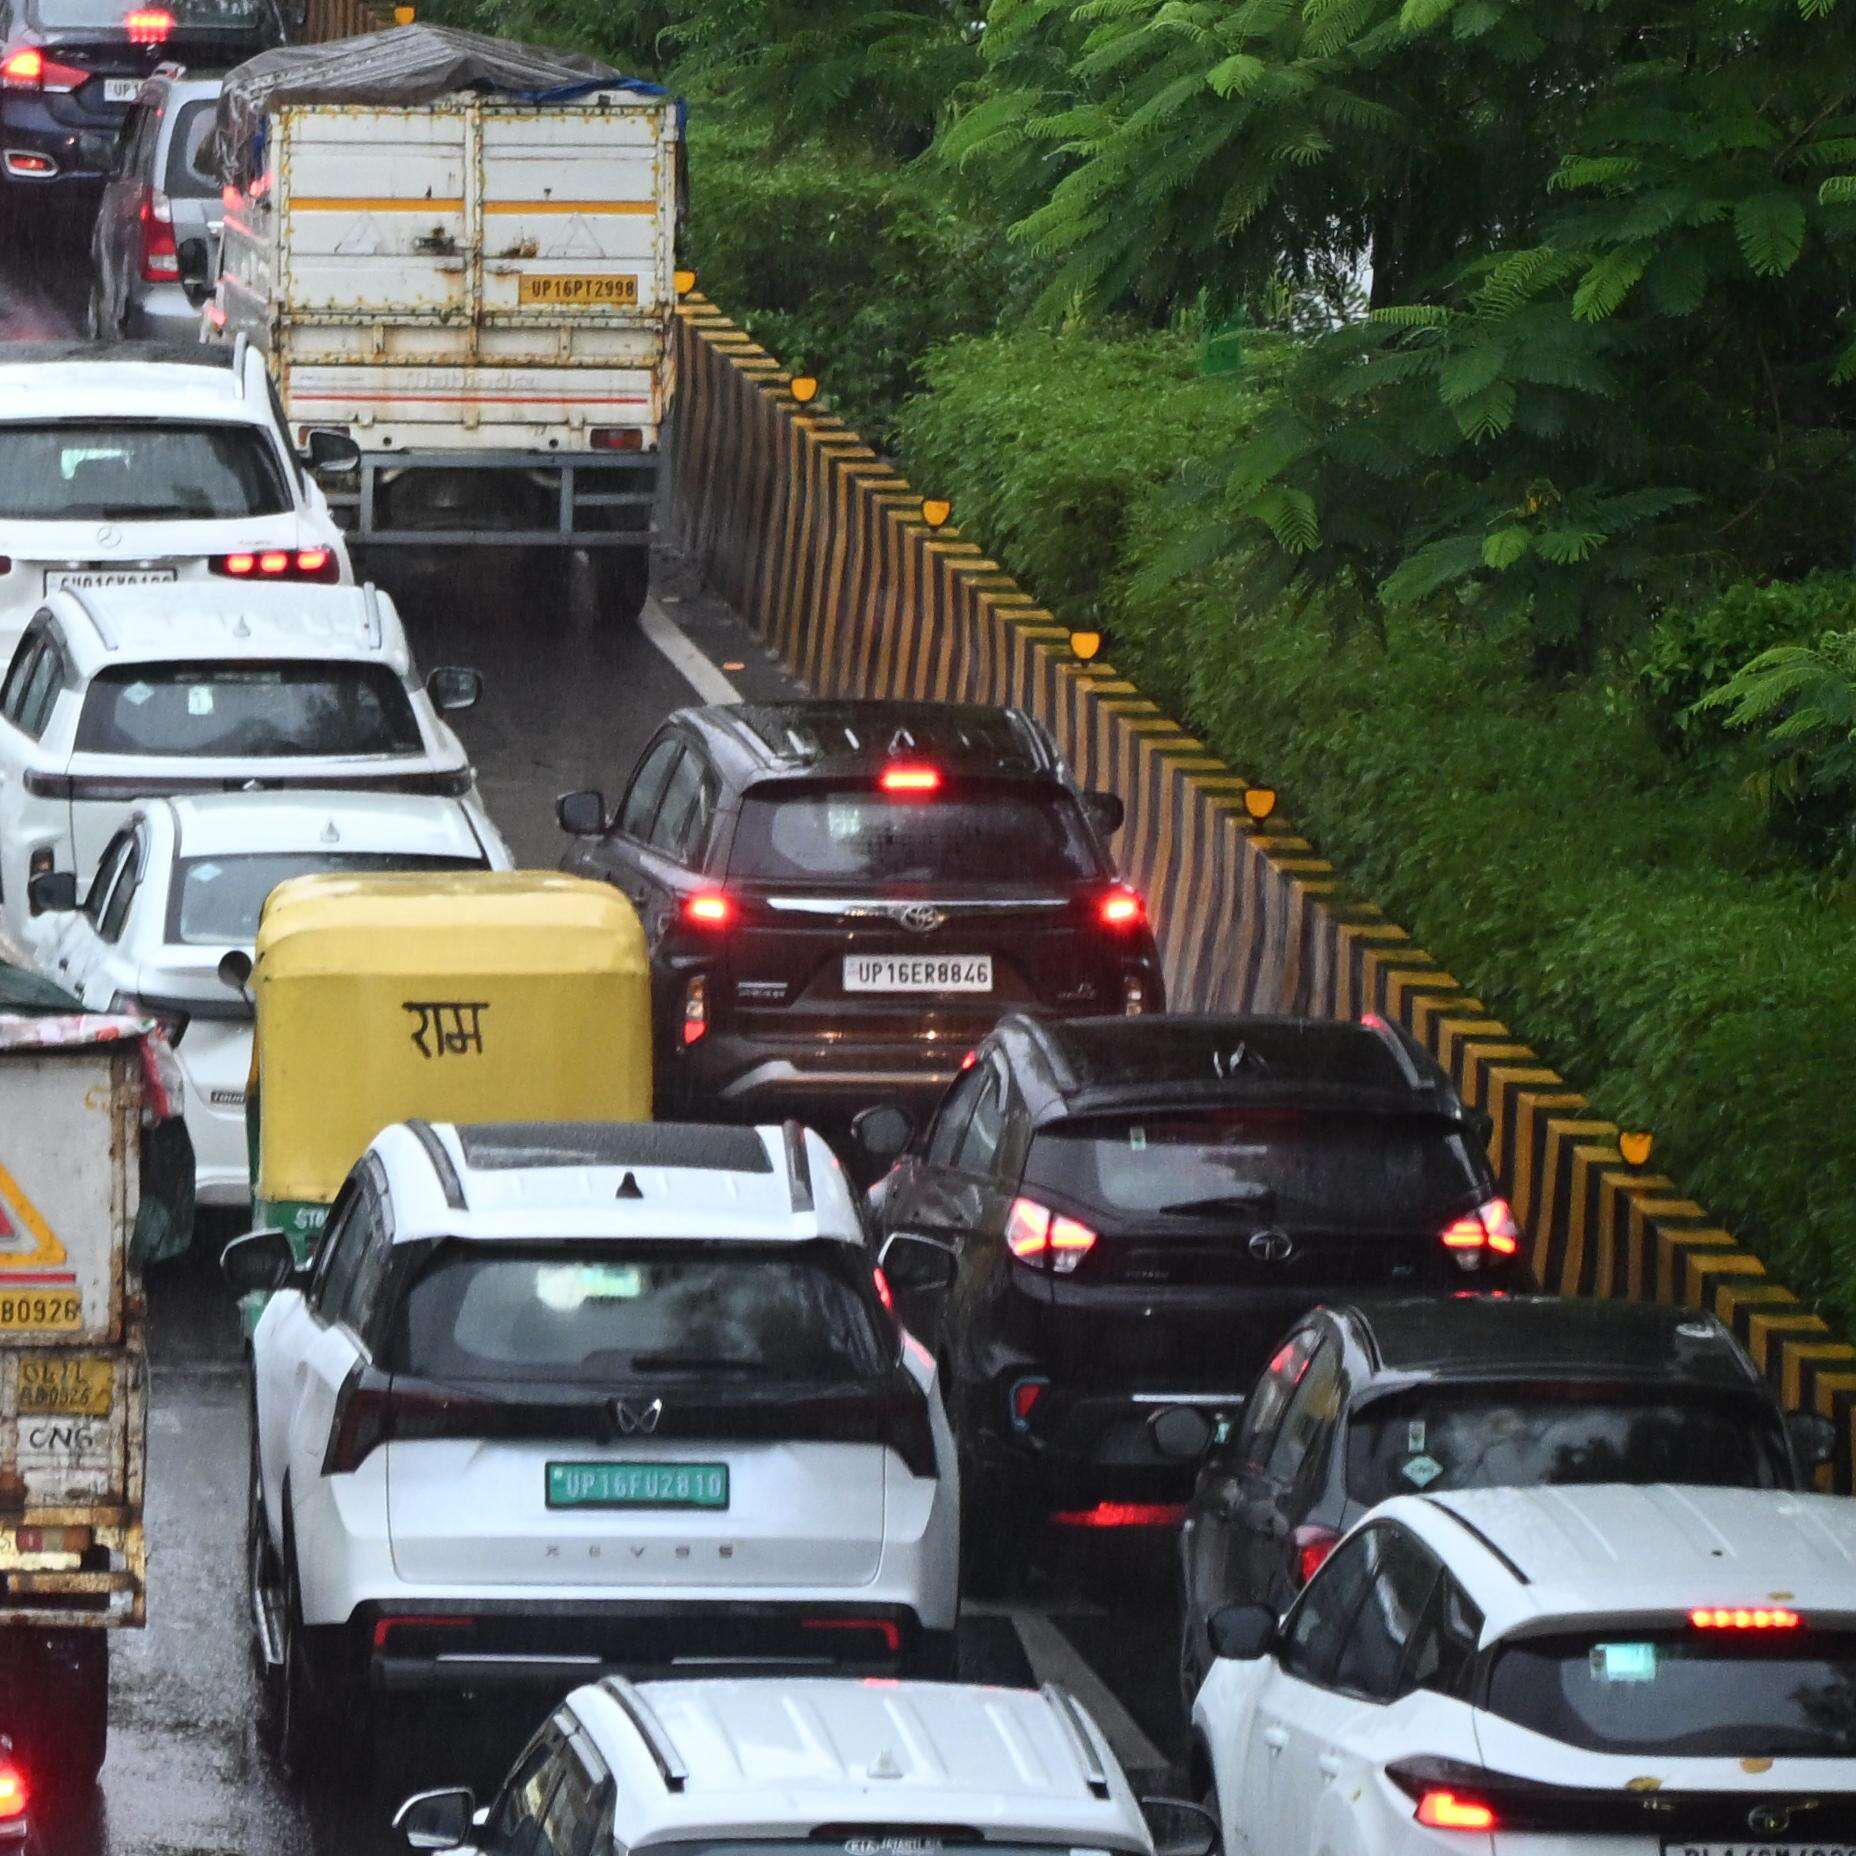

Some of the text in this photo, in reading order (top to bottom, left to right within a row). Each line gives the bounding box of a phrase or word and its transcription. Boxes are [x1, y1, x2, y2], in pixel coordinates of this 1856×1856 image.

[532, 280, 635, 300] UP16PT2998
[858, 961, 991, 986] UP16ER8846
[402, 1000, 490, 1059] राम
[28, 1427, 94, 1450] CNG
[565, 1471, 723, 1499] UP16FU2810
